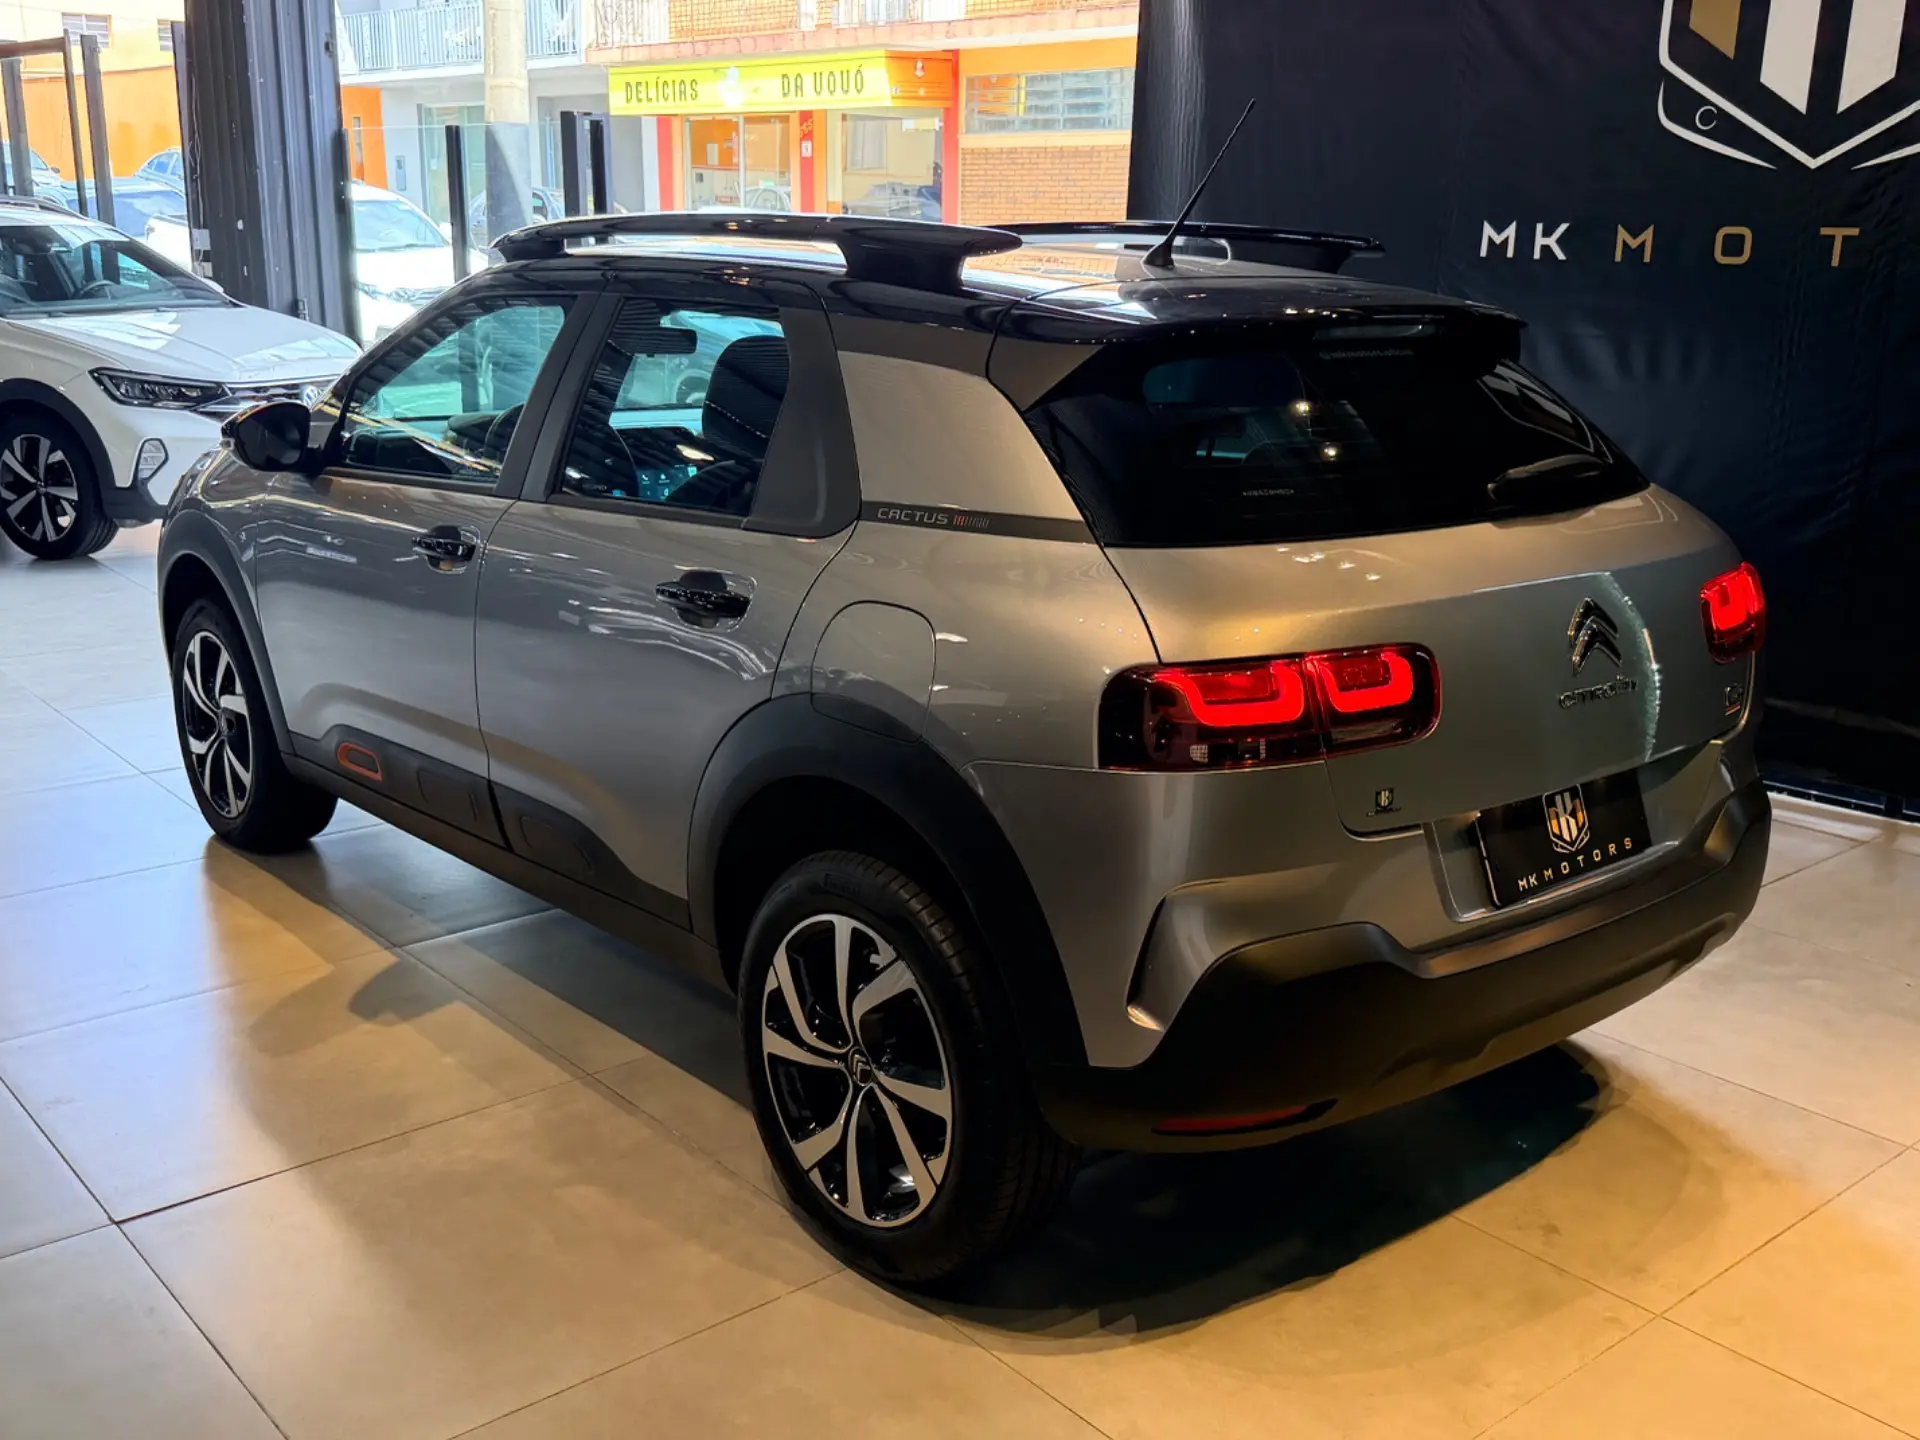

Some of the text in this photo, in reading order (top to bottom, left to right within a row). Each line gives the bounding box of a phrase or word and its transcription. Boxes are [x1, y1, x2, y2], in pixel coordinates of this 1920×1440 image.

[625, 76, 698, 104] DELÍCIAS
[781, 72, 804, 98] DA
[1479, 219, 1571, 261] MK
[877, 507, 949, 525] CACTUS
[1518, 837, 1632, 892] MK MOTORS
